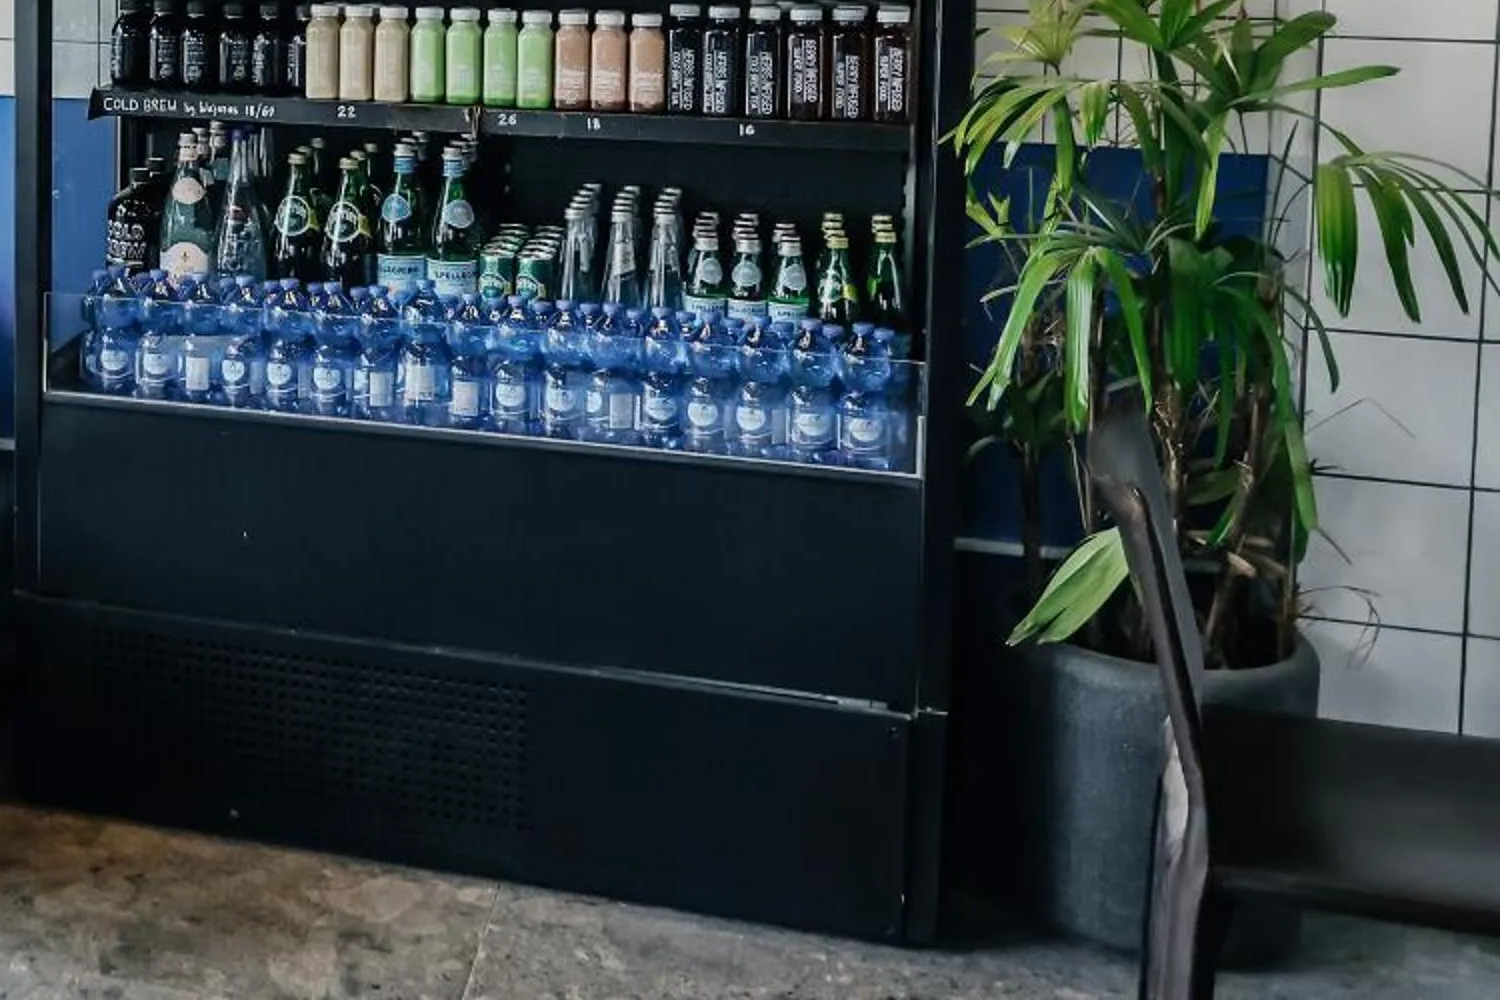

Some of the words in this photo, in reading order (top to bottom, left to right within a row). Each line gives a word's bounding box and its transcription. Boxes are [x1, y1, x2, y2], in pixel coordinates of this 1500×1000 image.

[103, 97, 139, 111] COLD
[143, 98, 177, 112] BREW
[337, 105, 357, 118] 22
[497, 113, 517, 126] 26
[739, 123, 755, 136] 16
